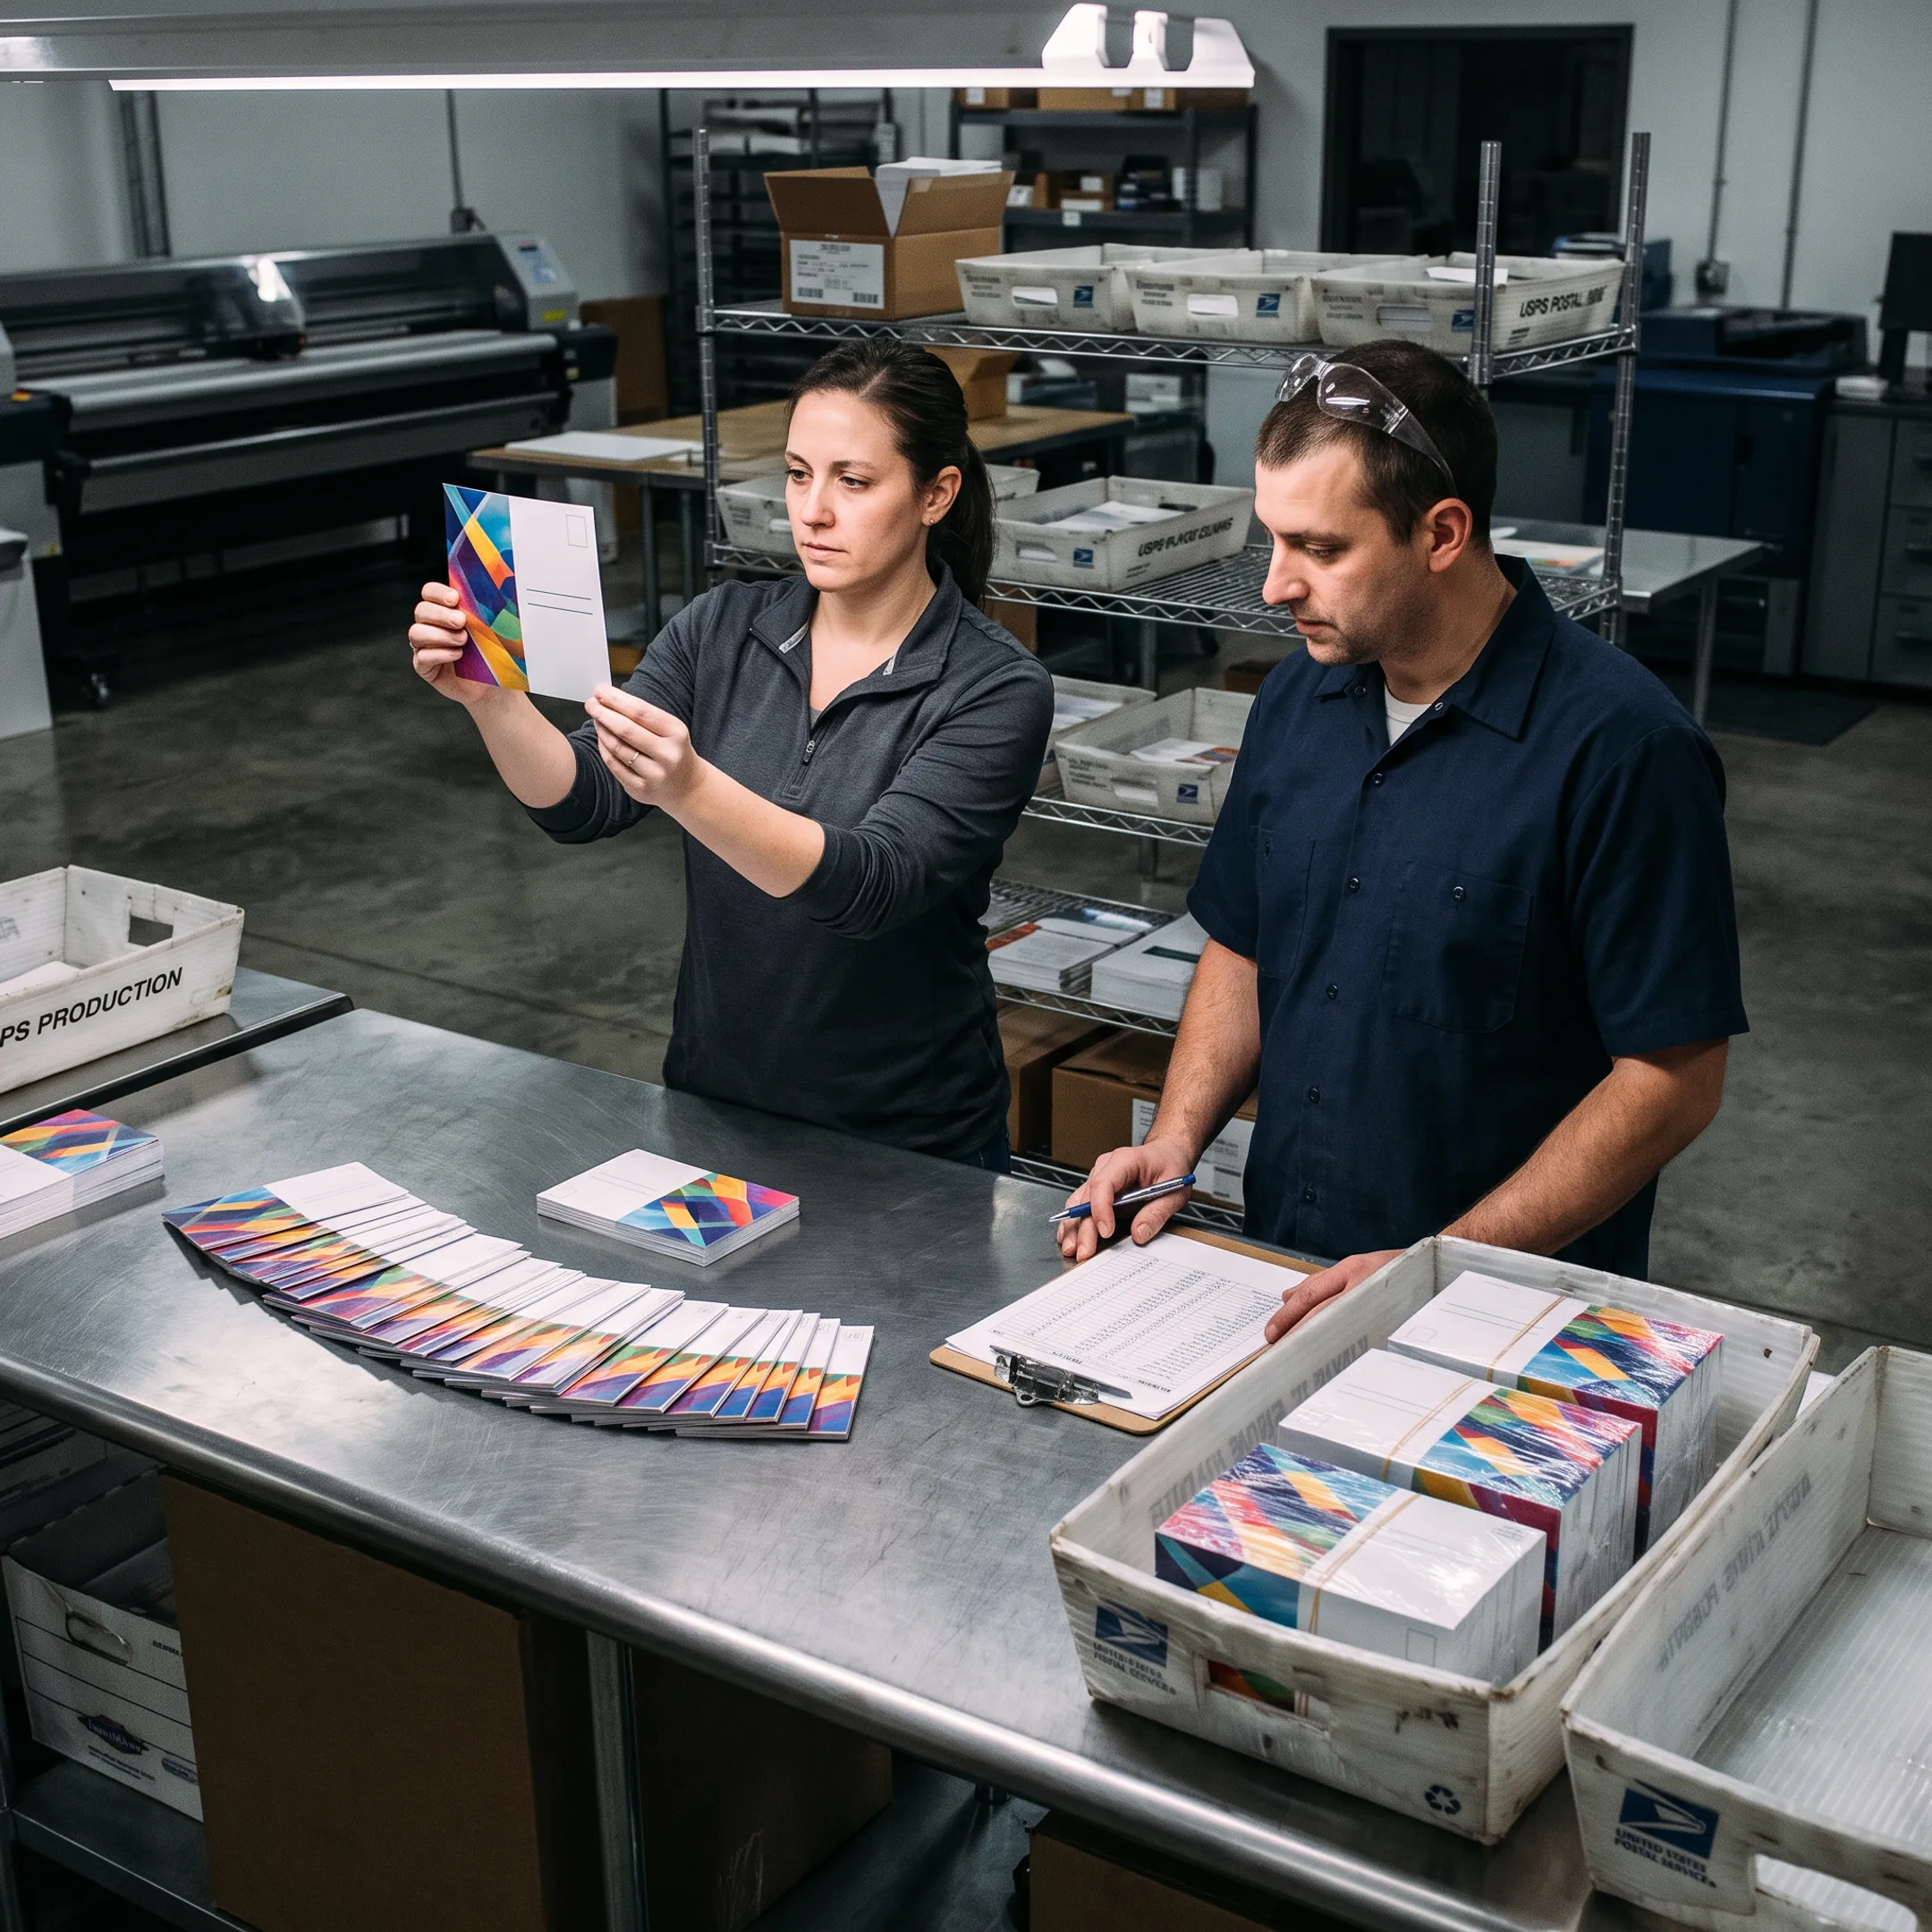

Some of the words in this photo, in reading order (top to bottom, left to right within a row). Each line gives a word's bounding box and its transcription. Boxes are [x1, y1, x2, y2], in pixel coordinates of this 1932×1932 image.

[1520, 298, 1548, 318] USPS
[1138, 537, 1165, 557] USPS
[37, 966, 183, 1035] PRODUCTION
